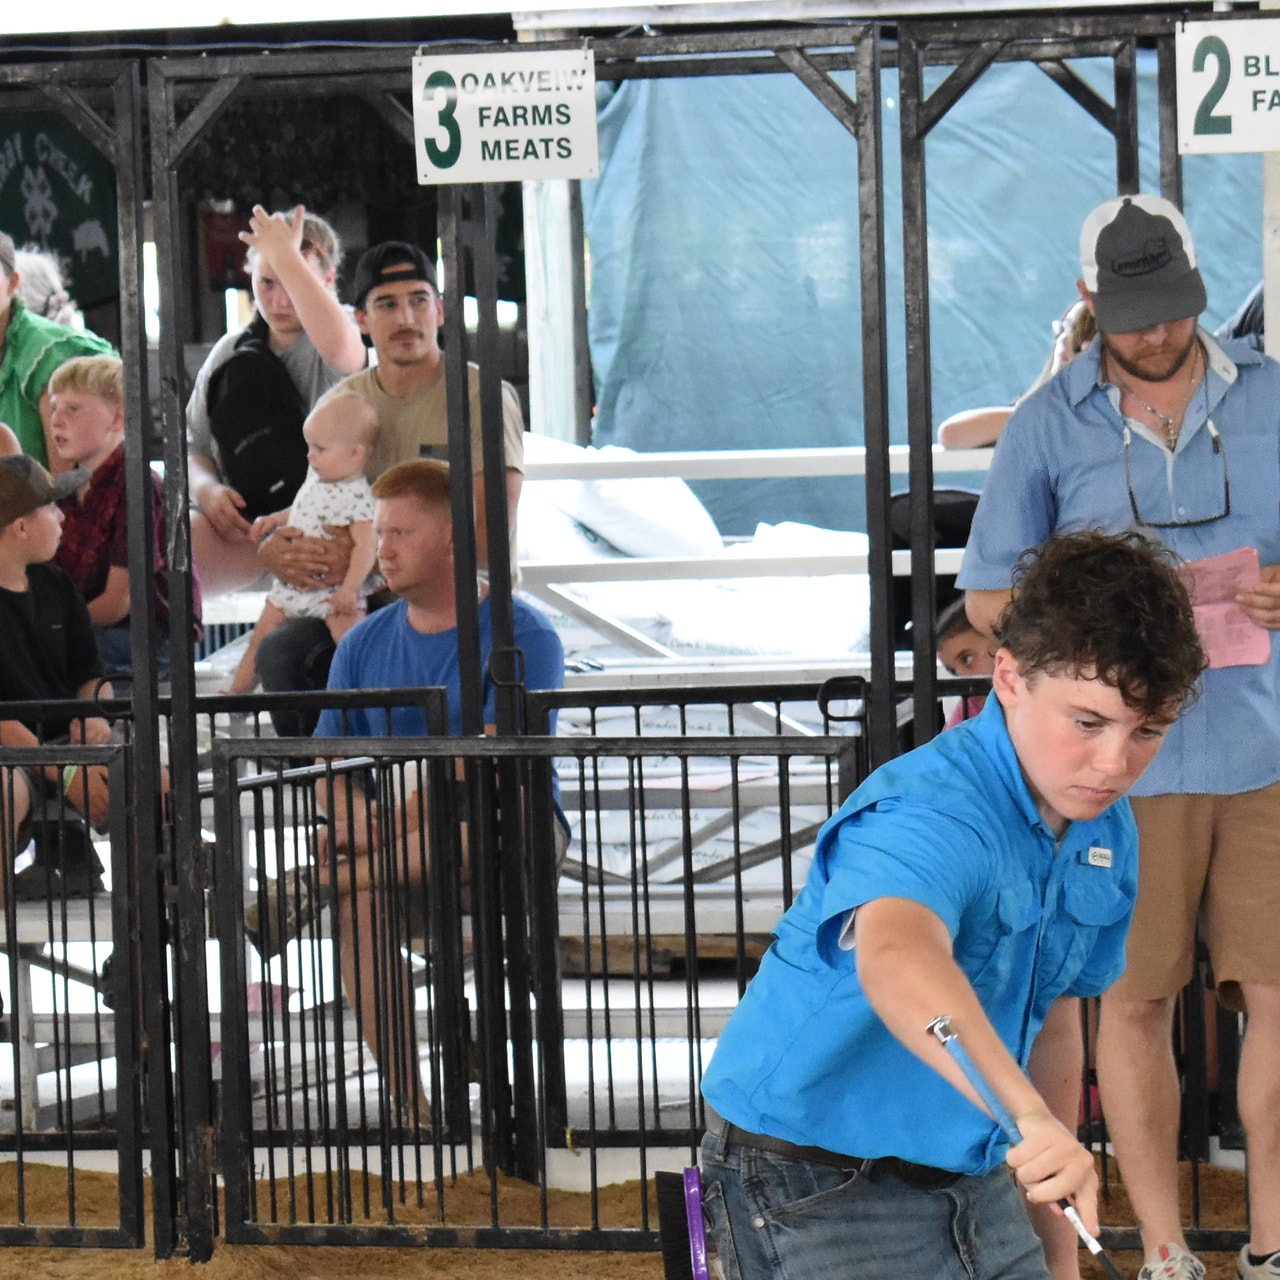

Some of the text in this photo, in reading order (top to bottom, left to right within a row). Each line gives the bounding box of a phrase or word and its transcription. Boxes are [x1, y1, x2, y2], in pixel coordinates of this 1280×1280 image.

[478, 103, 571, 128] FARMS
[1192, 35, 1233, 136] 2
[422, 70, 462, 170] 3
[480, 137, 573, 161] MEATS
